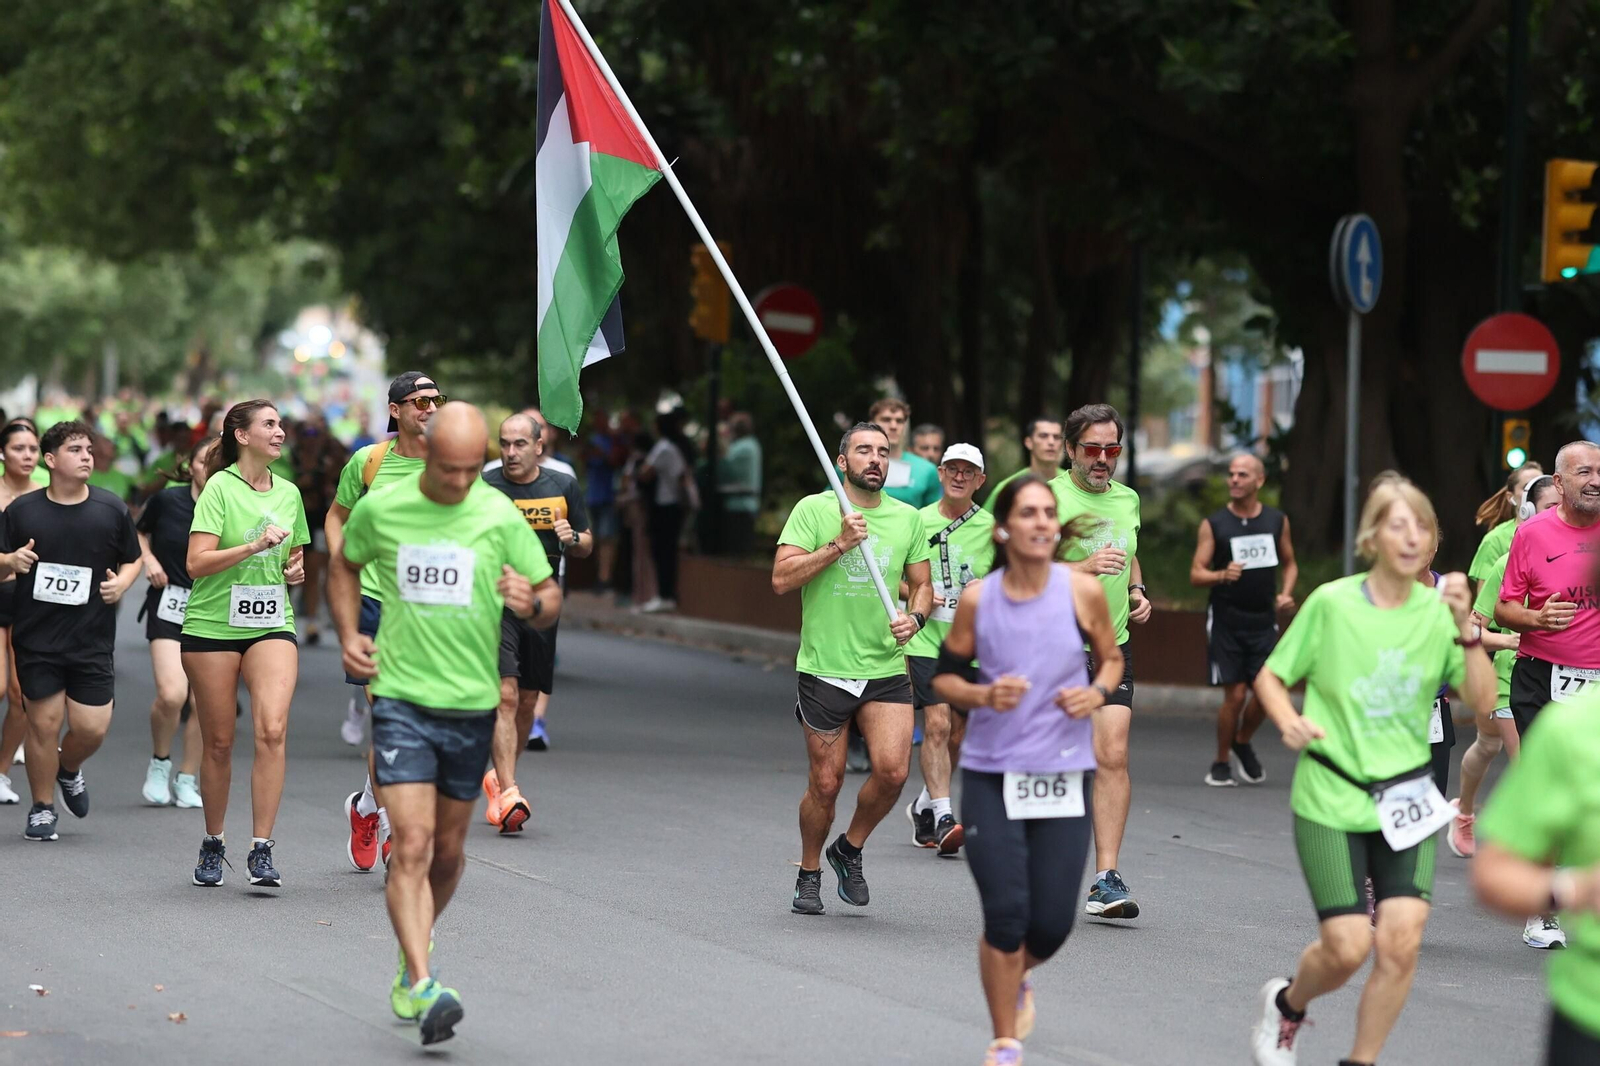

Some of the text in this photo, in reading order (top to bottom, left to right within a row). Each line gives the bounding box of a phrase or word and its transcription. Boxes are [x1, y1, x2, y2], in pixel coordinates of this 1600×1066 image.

[1240, 546, 1268, 560] 307
[407, 565, 459, 586] 980
[44, 576, 81, 593] 707
[237, 599, 278, 615] 803
[1017, 780, 1067, 800] 506
